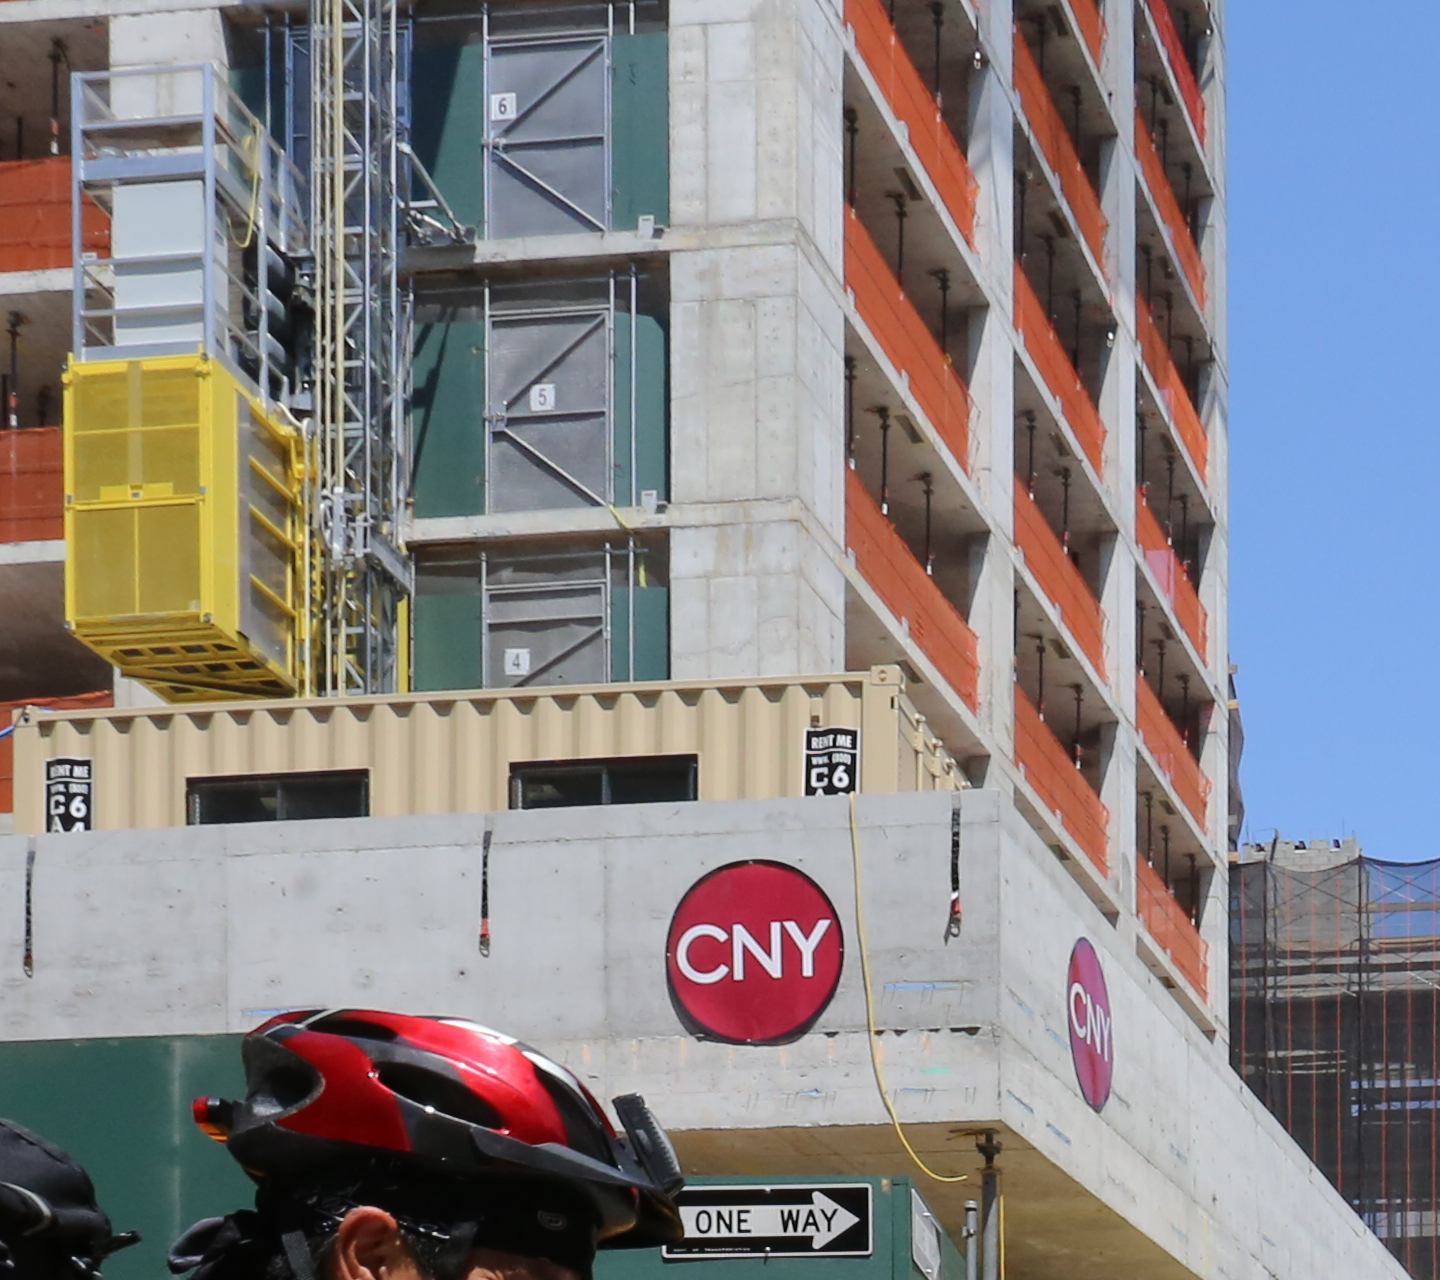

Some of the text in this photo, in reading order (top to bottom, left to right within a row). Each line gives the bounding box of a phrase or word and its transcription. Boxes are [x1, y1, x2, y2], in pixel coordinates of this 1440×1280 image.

[498, 97, 508, 115] 6
[537, 386, 549, 407] 5
[510, 650, 522, 671] 4
[810, 733, 853, 750] RENT ME
[72, 765, 89, 778] ME
[675, 918, 833, 985] CNY
[1069, 981, 1111, 1063] CNY
[695, 1208, 839, 1234] ONE WAY
